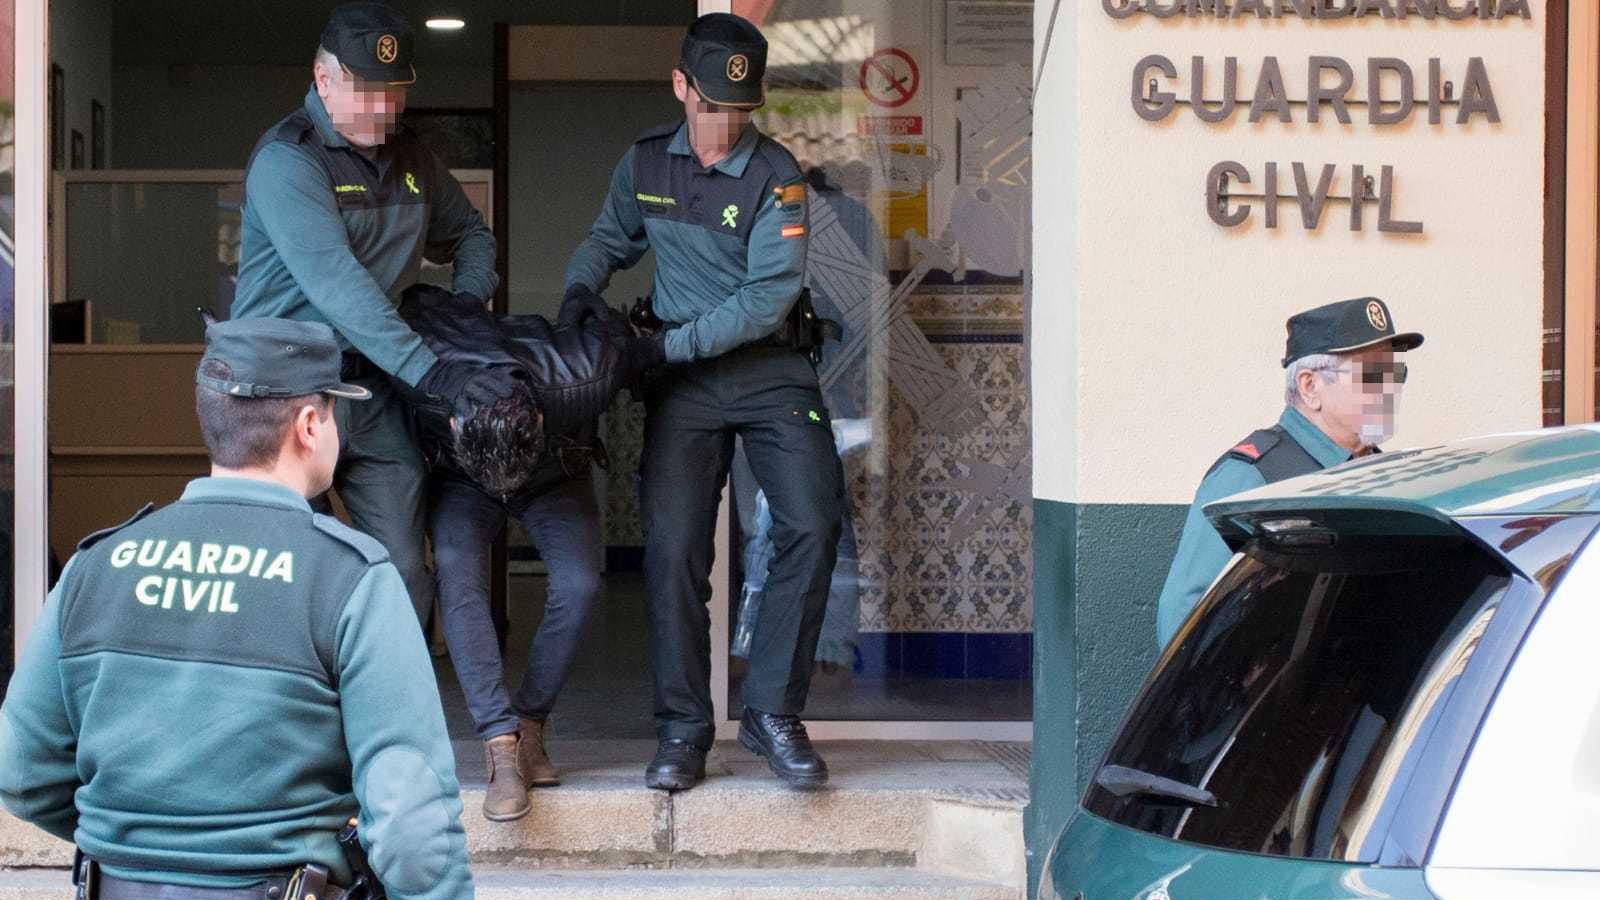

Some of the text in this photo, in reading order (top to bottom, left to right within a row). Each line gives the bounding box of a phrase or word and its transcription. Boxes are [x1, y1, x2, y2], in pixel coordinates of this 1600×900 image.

[1131, 54, 1501, 124] GUARDIA
[1206, 161, 1424, 234] CIVIL
[110, 540, 294, 583] GUARDIA
[135, 575, 239, 613] CIVIL
